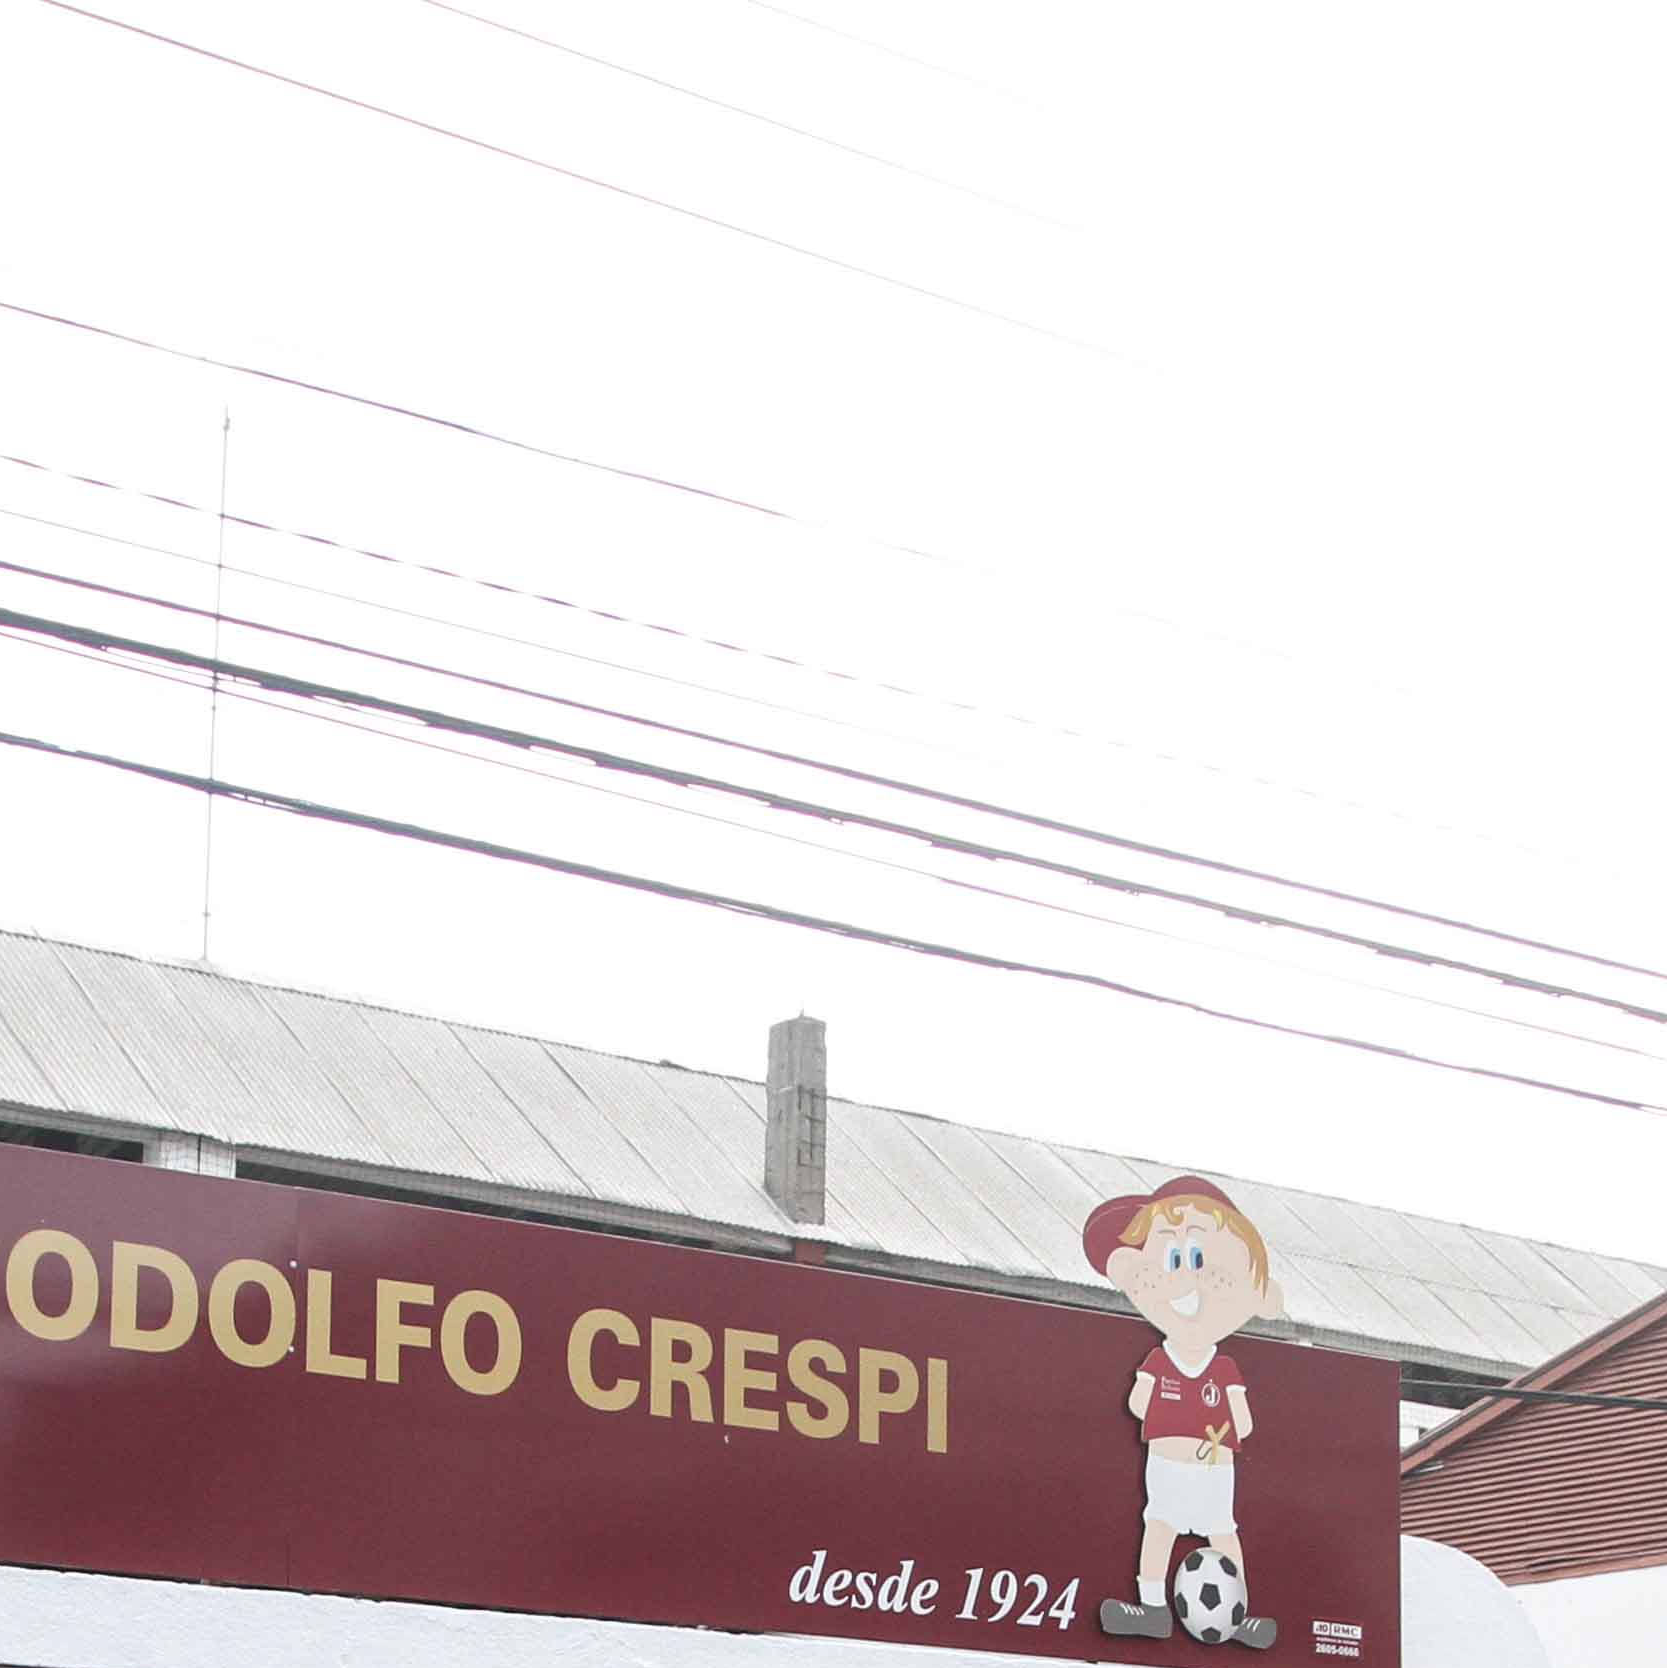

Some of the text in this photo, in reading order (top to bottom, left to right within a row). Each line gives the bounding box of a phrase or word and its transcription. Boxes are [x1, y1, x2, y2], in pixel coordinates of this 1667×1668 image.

[566, 1306, 950, 1455] CRESPI
[788, 1549, 1081, 1631] desde 1924
